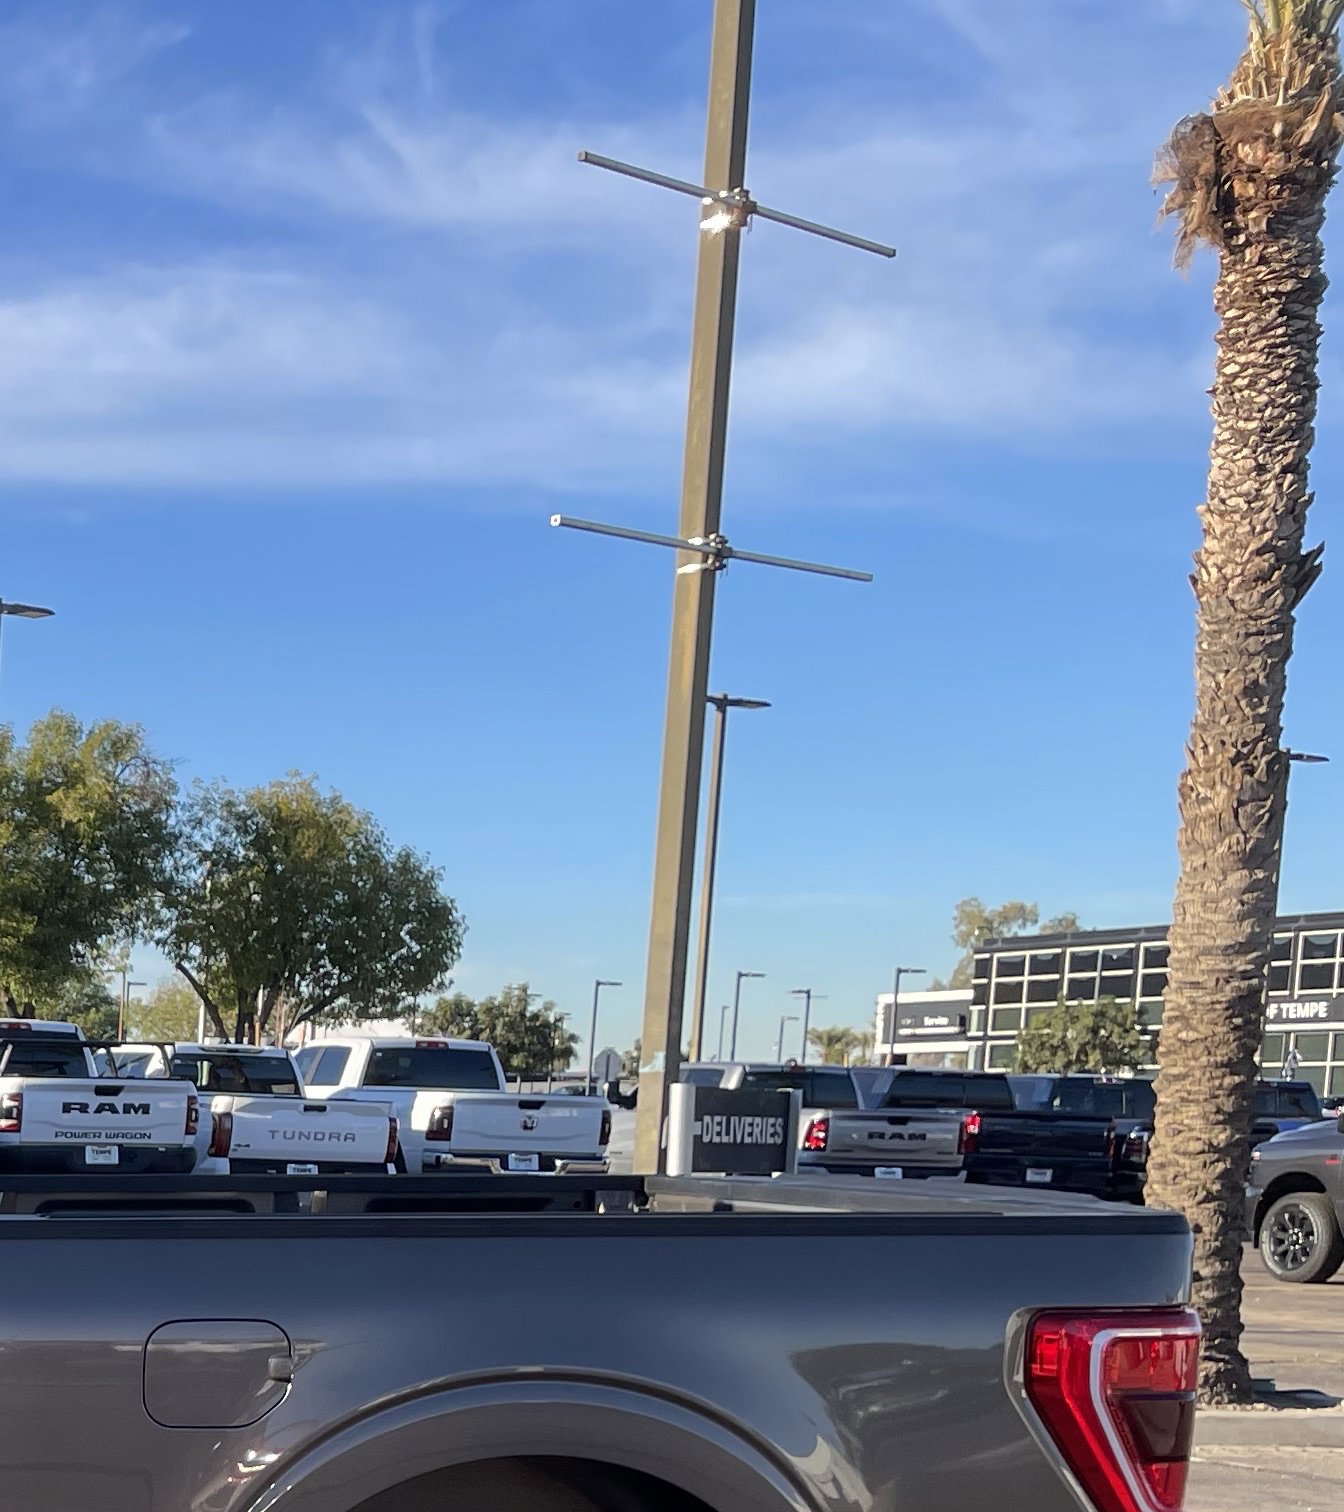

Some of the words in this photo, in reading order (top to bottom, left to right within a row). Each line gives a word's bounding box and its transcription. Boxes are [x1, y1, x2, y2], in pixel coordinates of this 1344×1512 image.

[1280, 1002, 1328, 1019] TEMPE
[62, 1102, 151, 1114] RAM
[55, 1131, 102, 1139] POWER
[105, 1131, 152, 1140] WAGON
[702, 1115, 784, 1144] DELIVERIES
[867, 1131, 927, 1140] RAM
[268, 1130, 356, 1142] TUNDRA
